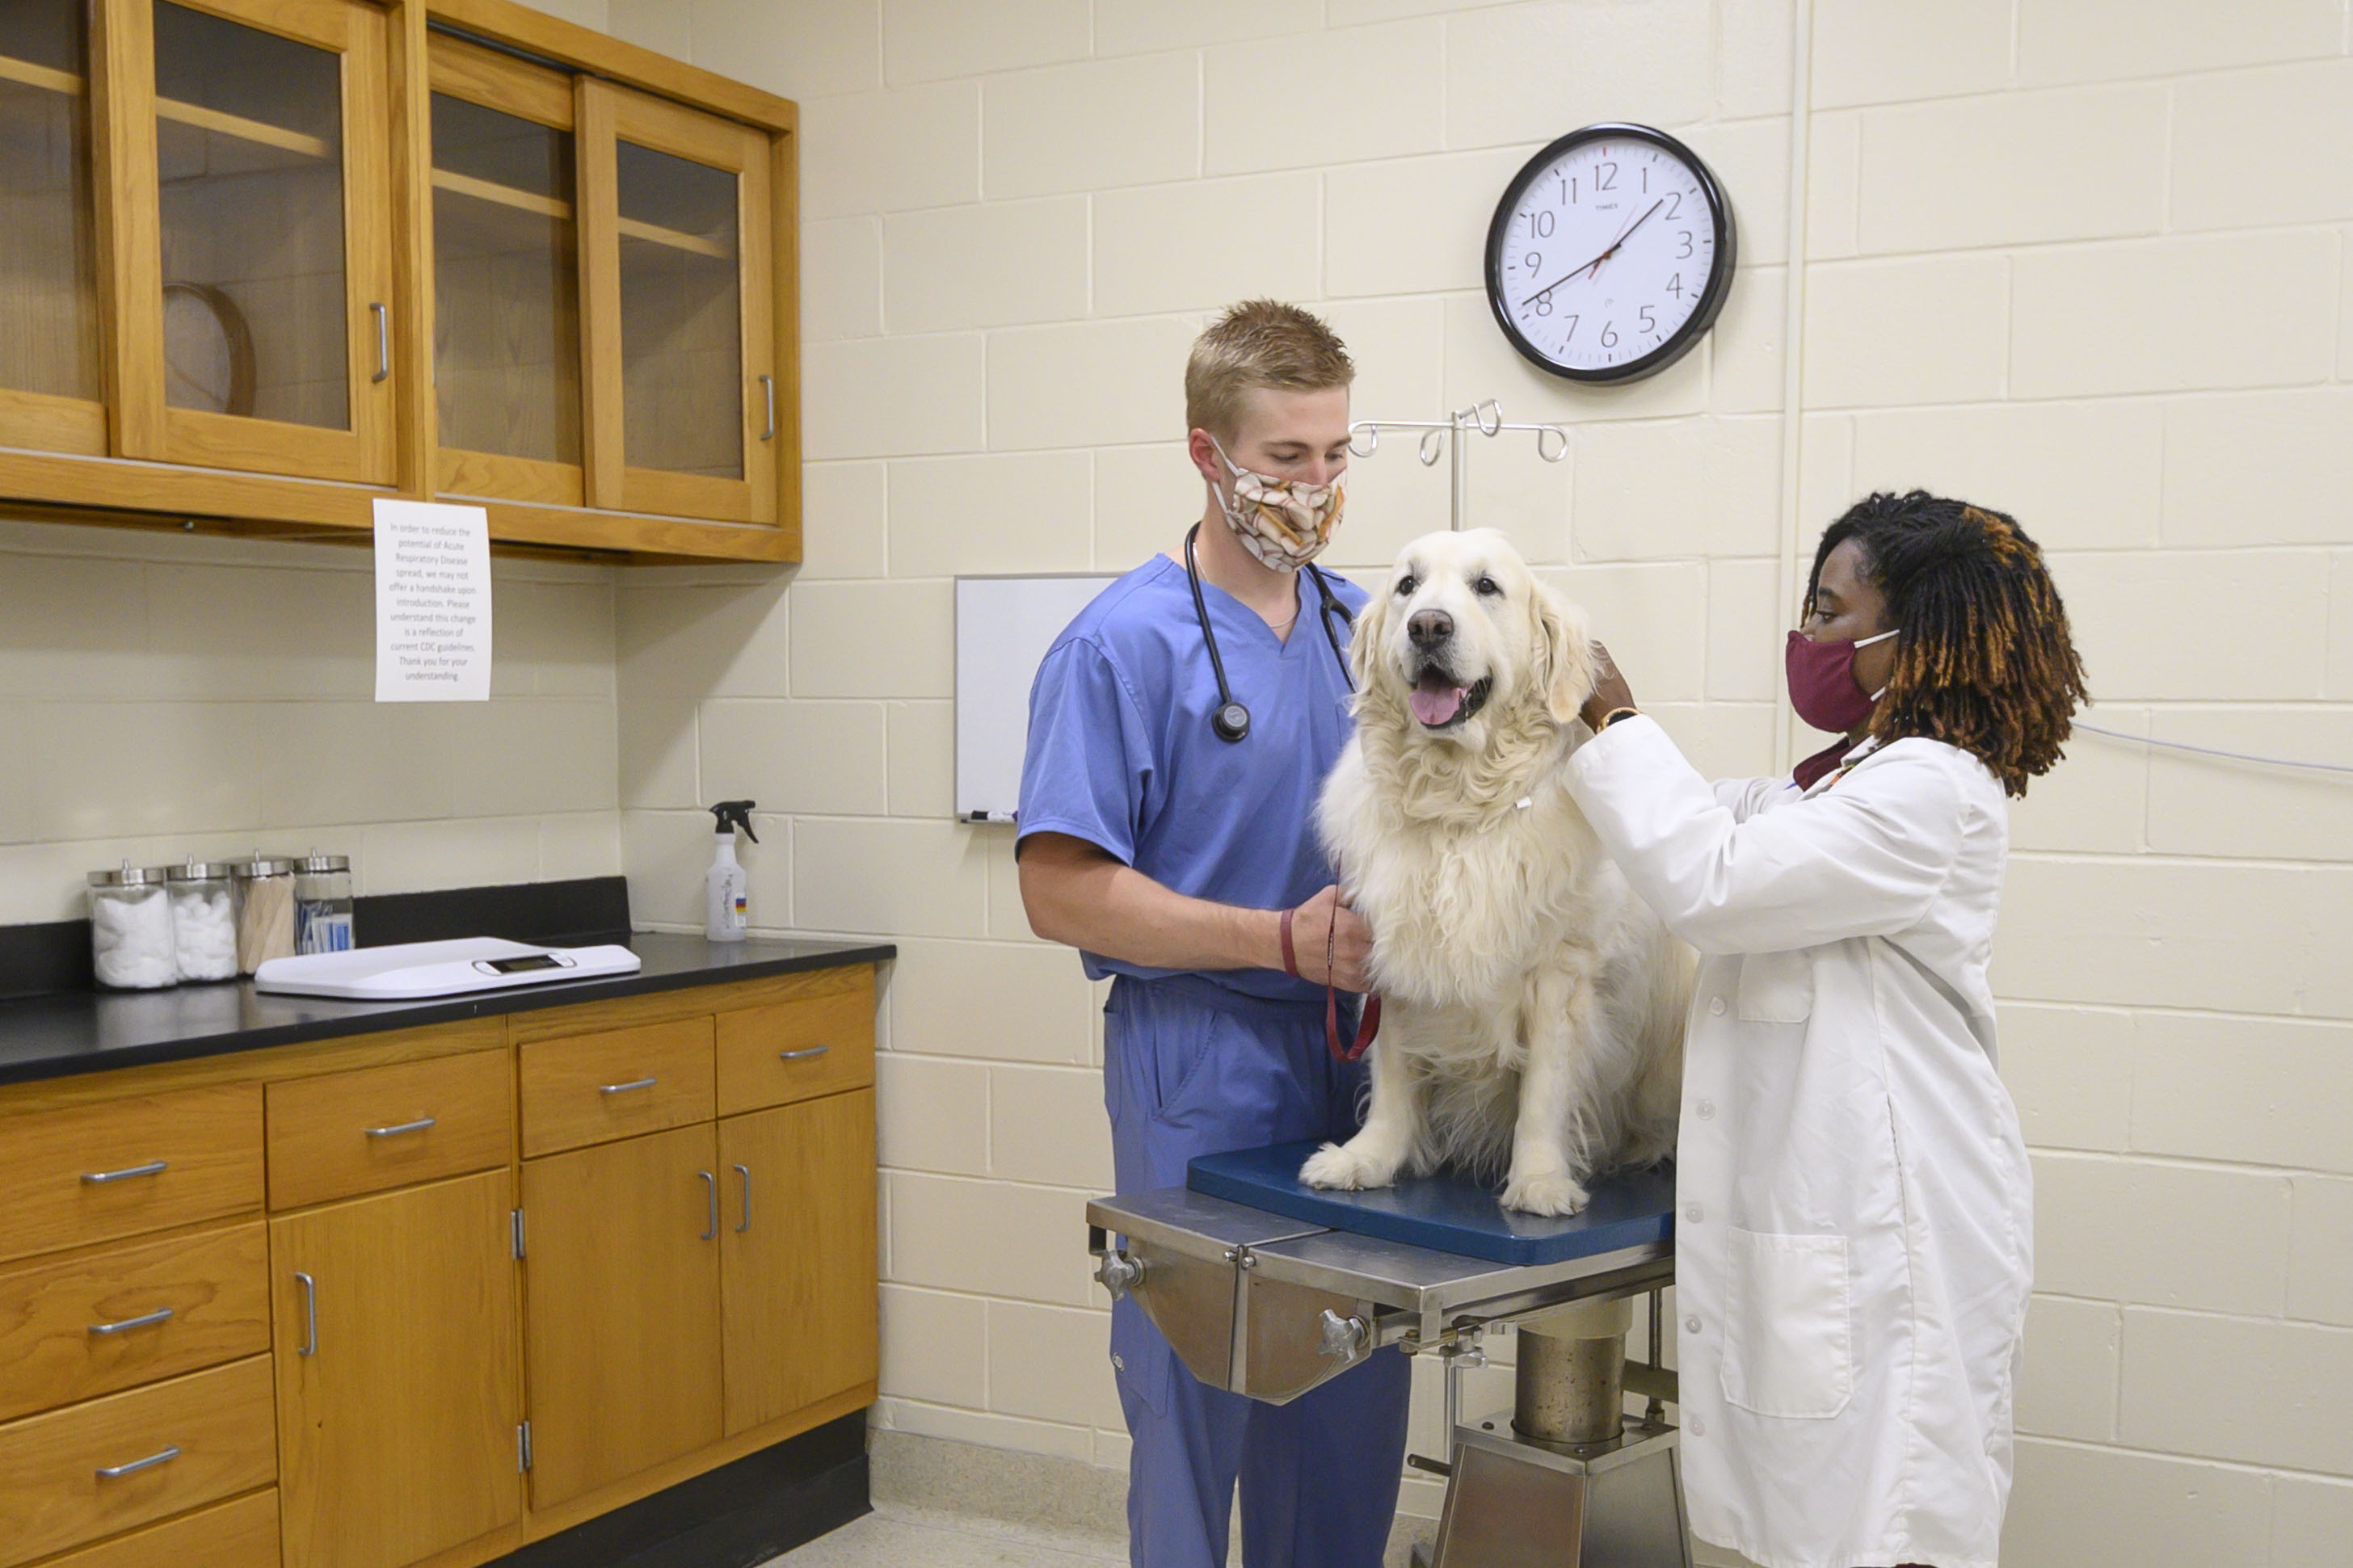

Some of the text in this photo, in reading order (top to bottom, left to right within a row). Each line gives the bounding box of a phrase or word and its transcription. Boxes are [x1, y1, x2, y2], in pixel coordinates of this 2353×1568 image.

[1594, 162, 1618, 191] 12
[1642, 167, 1648, 194] 1
[1560, 177, 1577, 206] 11
[1664, 191, 1682, 221] 2
[1529, 210, 1555, 239] 10
[1675, 231, 1693, 259] 3
[1524, 251, 1542, 279] 9
[1666, 272, 1684, 300] 4
[1535, 288, 1553, 317] 8
[1564, 314, 1579, 343] 7
[1639, 305, 1656, 334] 5
[1601, 321, 1618, 348] 6
[390, 523, 471, 536] In order to reduce the
[398, 540, 465, 551] potential of Acute
[395, 553, 468, 566] Respiratory Disease
[389, 582, 407, 591] offer
[416, 583, 456, 593] handshake
[457, 587, 477, 595] upon
[396, 569, 424, 579] spread,
[439, 572, 455, 581] may
[457, 571, 469, 580] not
[447, 599, 469, 608] Please
[390, 612, 476, 624] understand this change
[404, 628, 410, 636] is
[419, 628, 453, 637] reflection
[456, 628, 464, 637] of
[390, 642, 419, 651] current
[420, 641, 436, 652] CDC
[399, 656, 468, 668] Thank you for your
